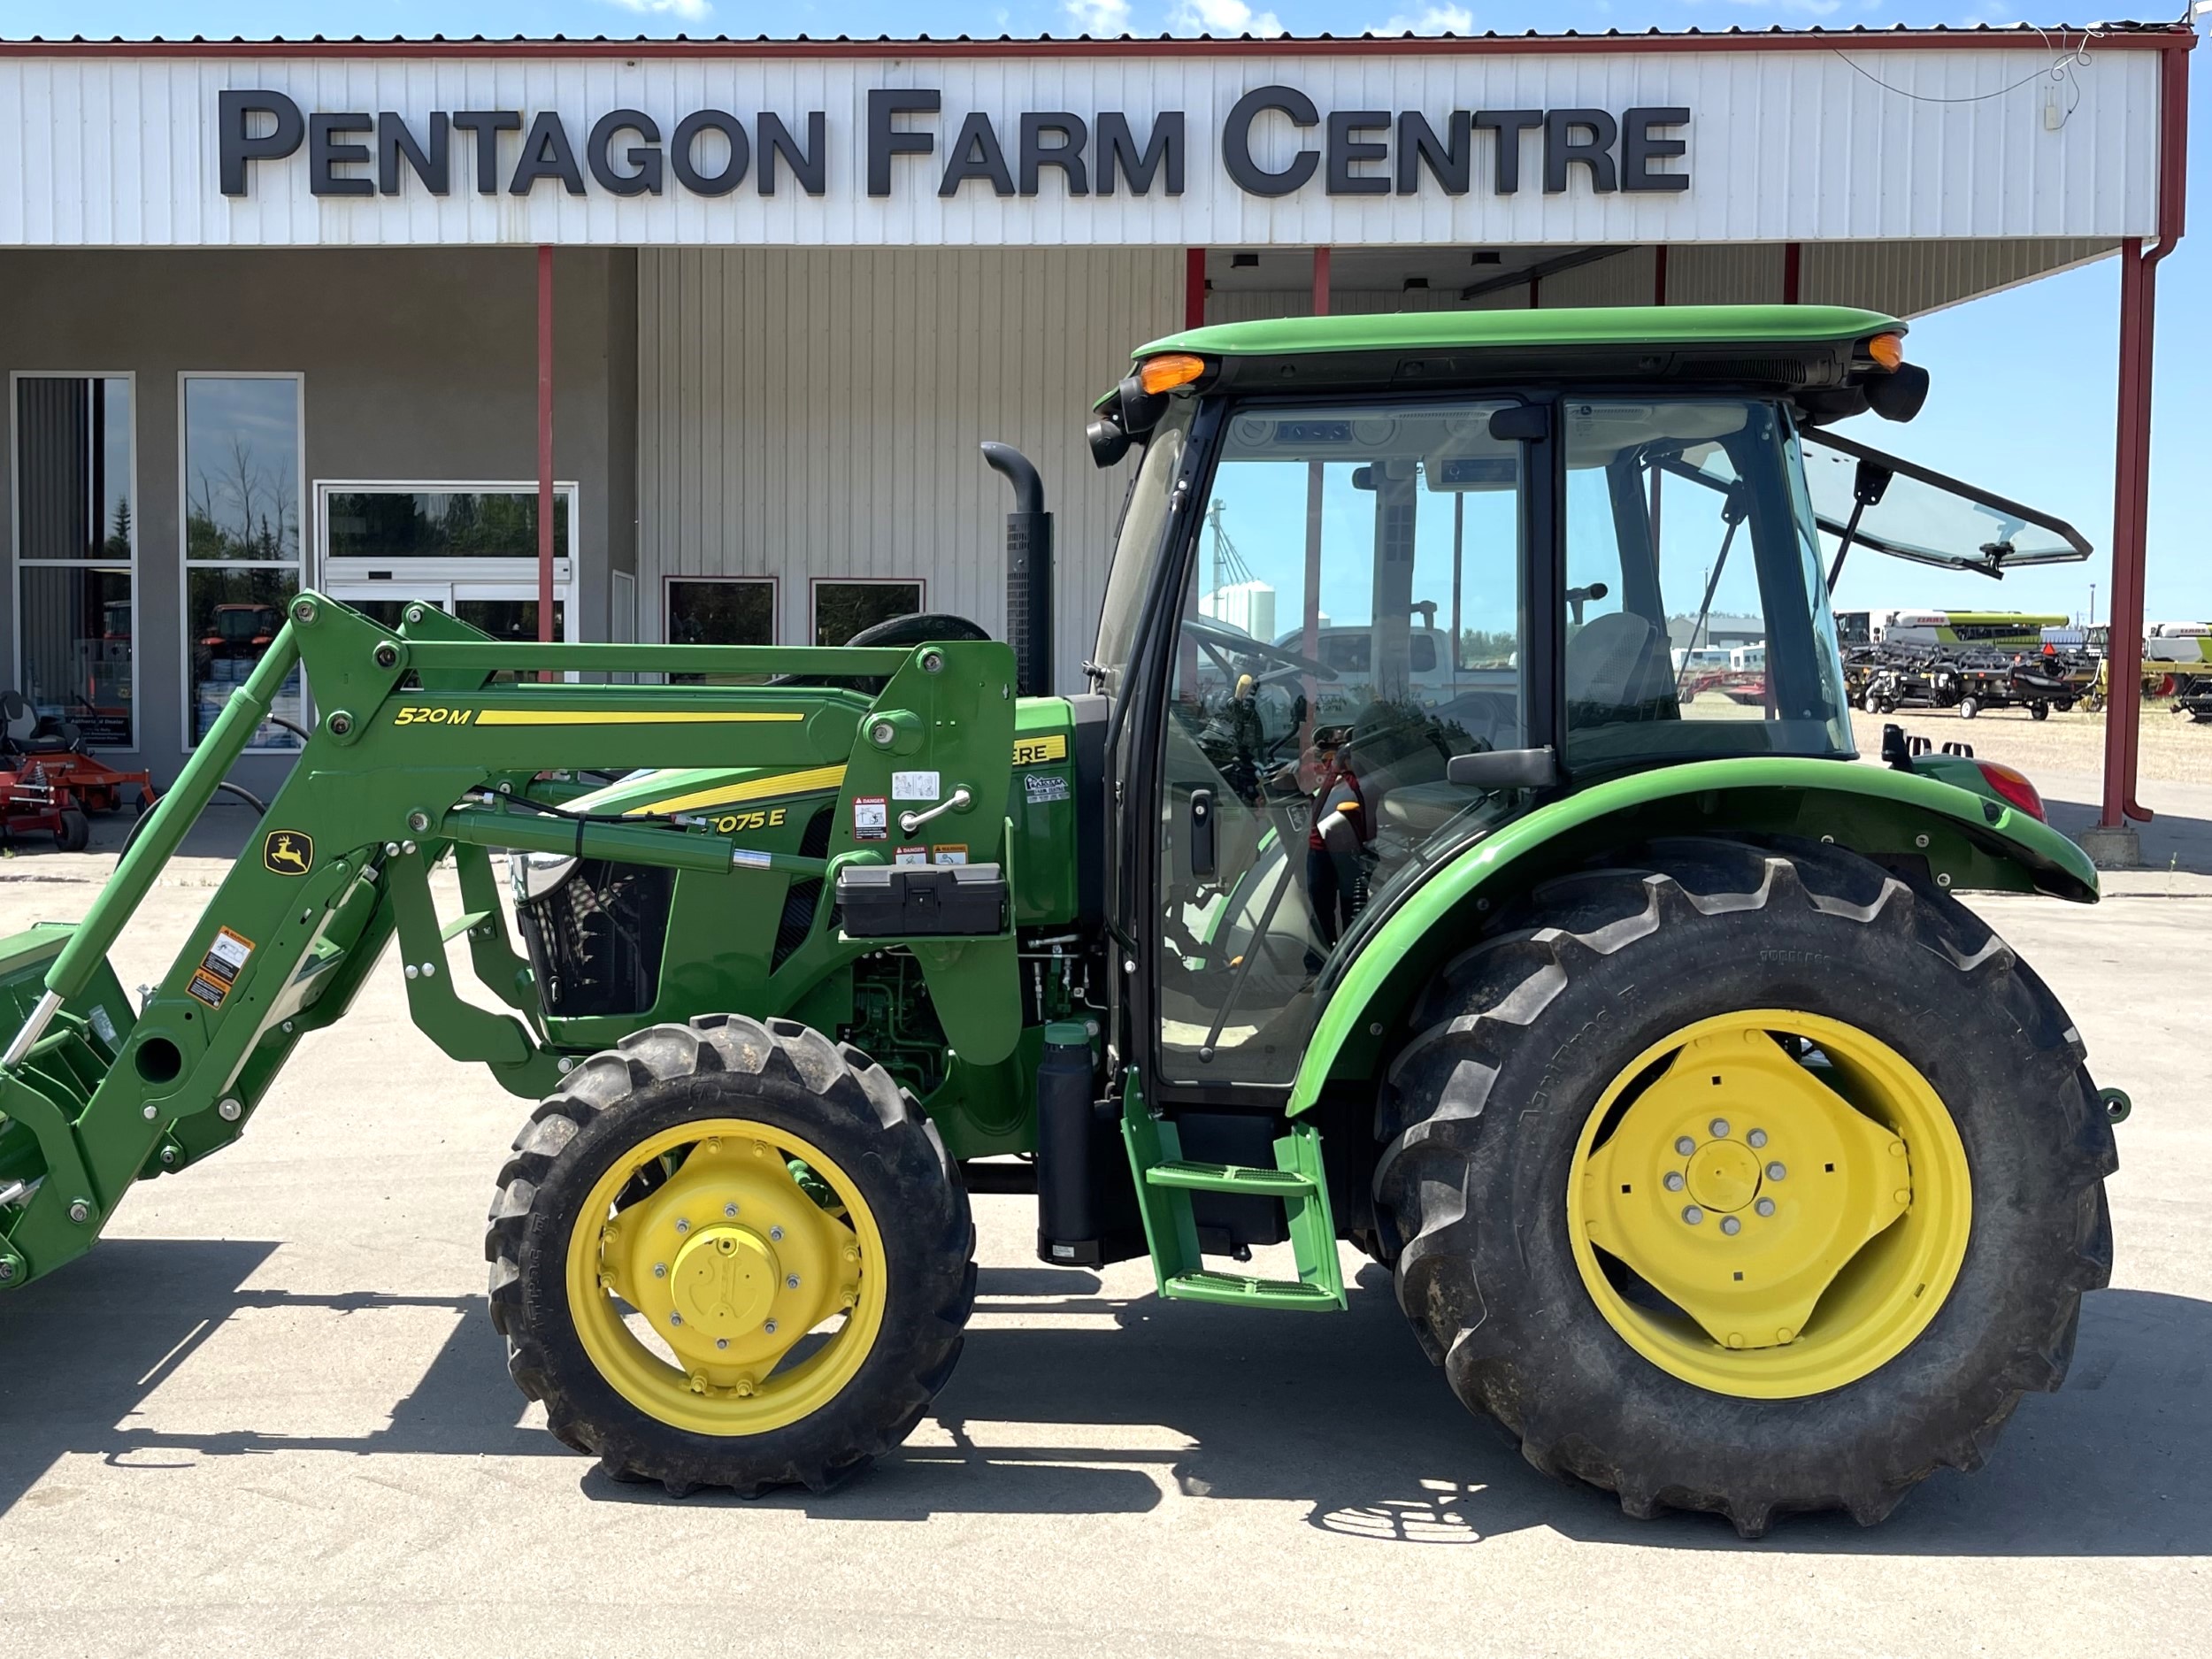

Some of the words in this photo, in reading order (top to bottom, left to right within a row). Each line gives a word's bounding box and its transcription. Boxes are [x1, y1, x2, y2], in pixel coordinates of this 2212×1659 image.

[219, 89, 826, 196] PENTAGON
[868, 88, 1185, 197] FARM
[1222, 85, 1691, 197] CENTRE
[394, 707, 472, 726] 520M
